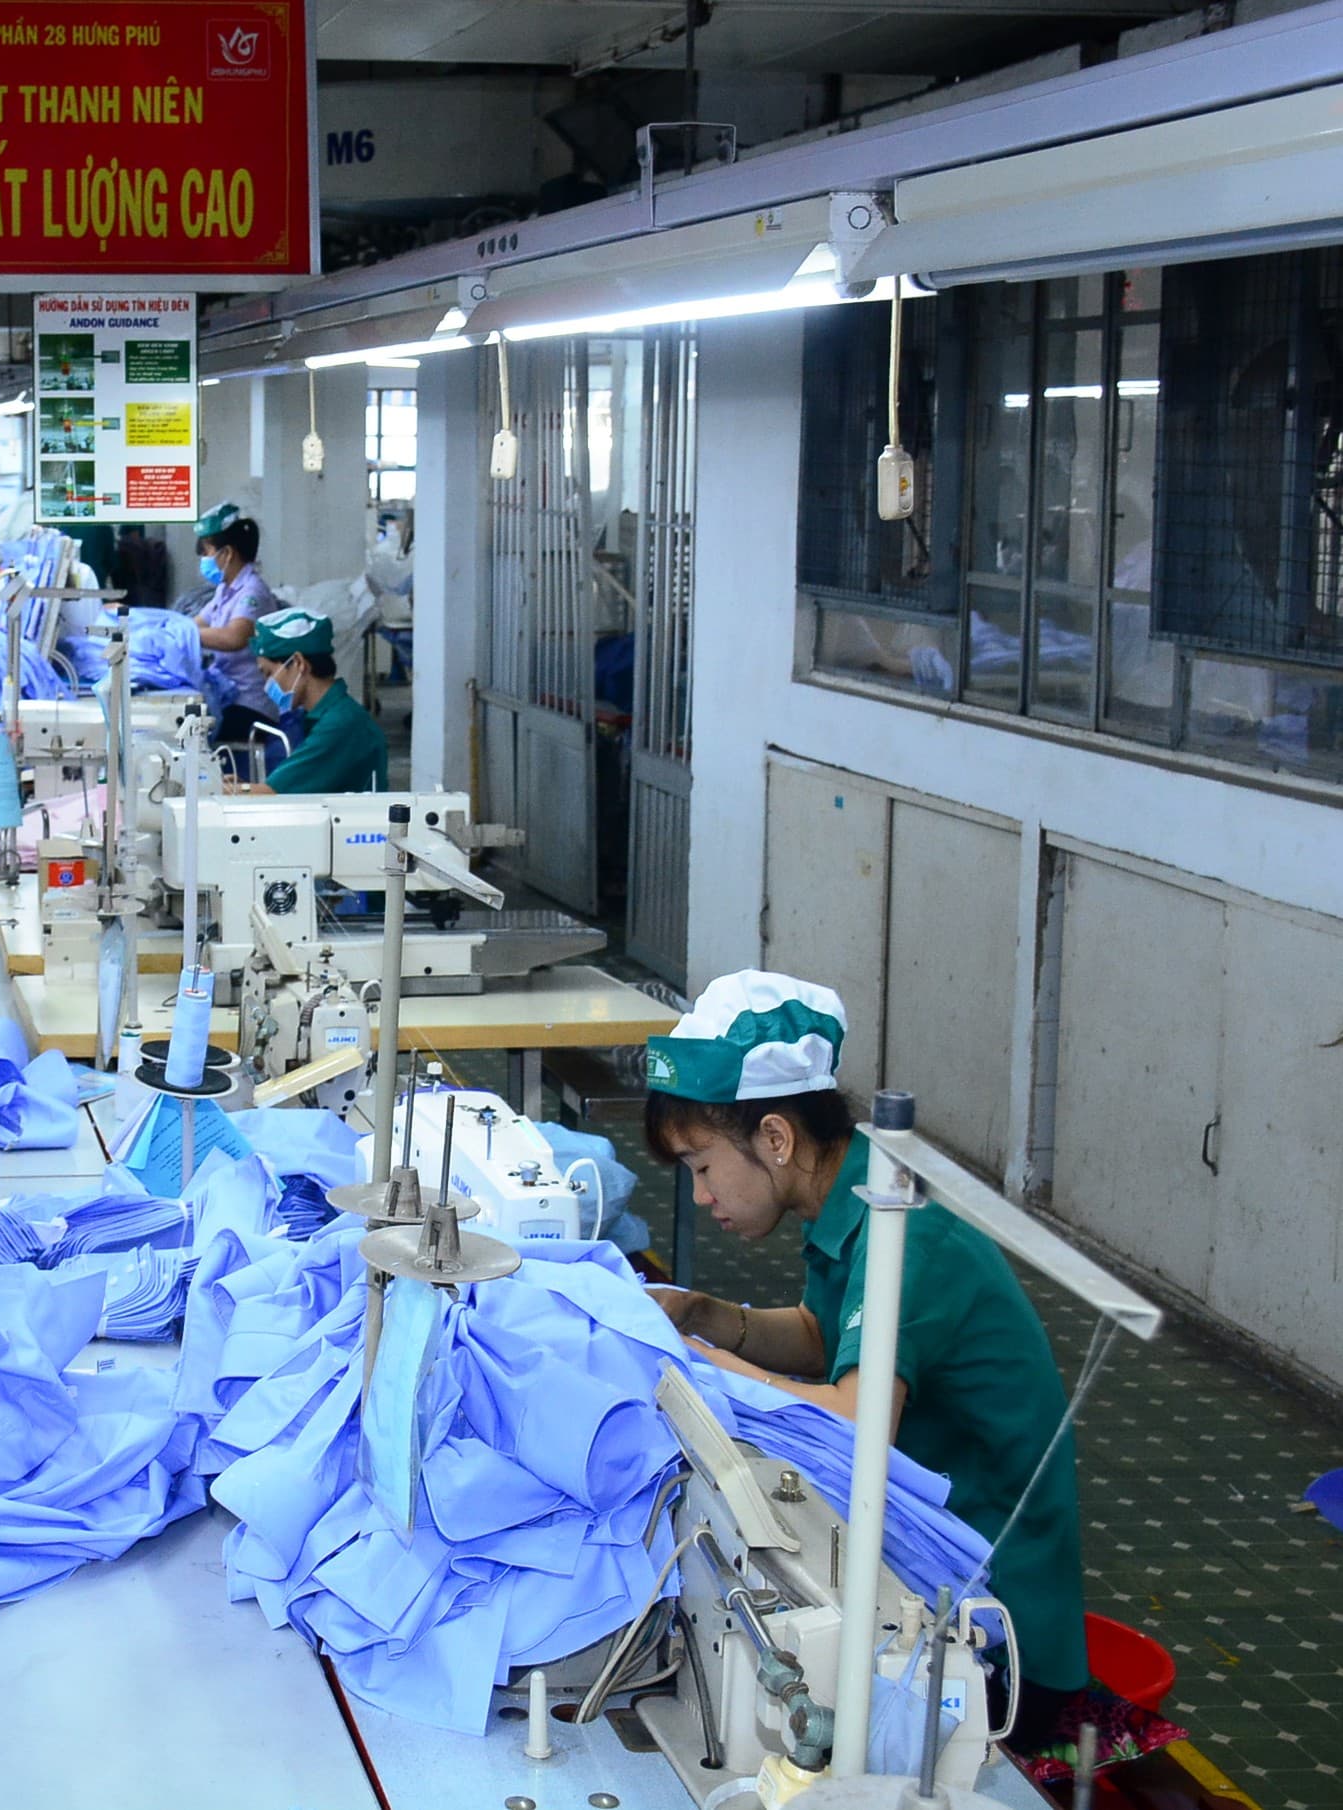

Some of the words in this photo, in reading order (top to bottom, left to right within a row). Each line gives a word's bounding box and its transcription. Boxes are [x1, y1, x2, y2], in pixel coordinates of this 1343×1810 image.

[44, 24, 67, 46] 28
[72, 21, 120, 46] HƯNG
[19, 85, 120, 124] THANH
[133, 76, 204, 125] NIÊN
[327, 129, 375, 165] M6
[43, 154, 168, 252] LƯỢNG
[180, 168, 254, 238] CAO
[69, 318, 105, 328] ANDON
[108, 318, 160, 328] GUIDANCE
[345, 833, 388, 845] JUK
